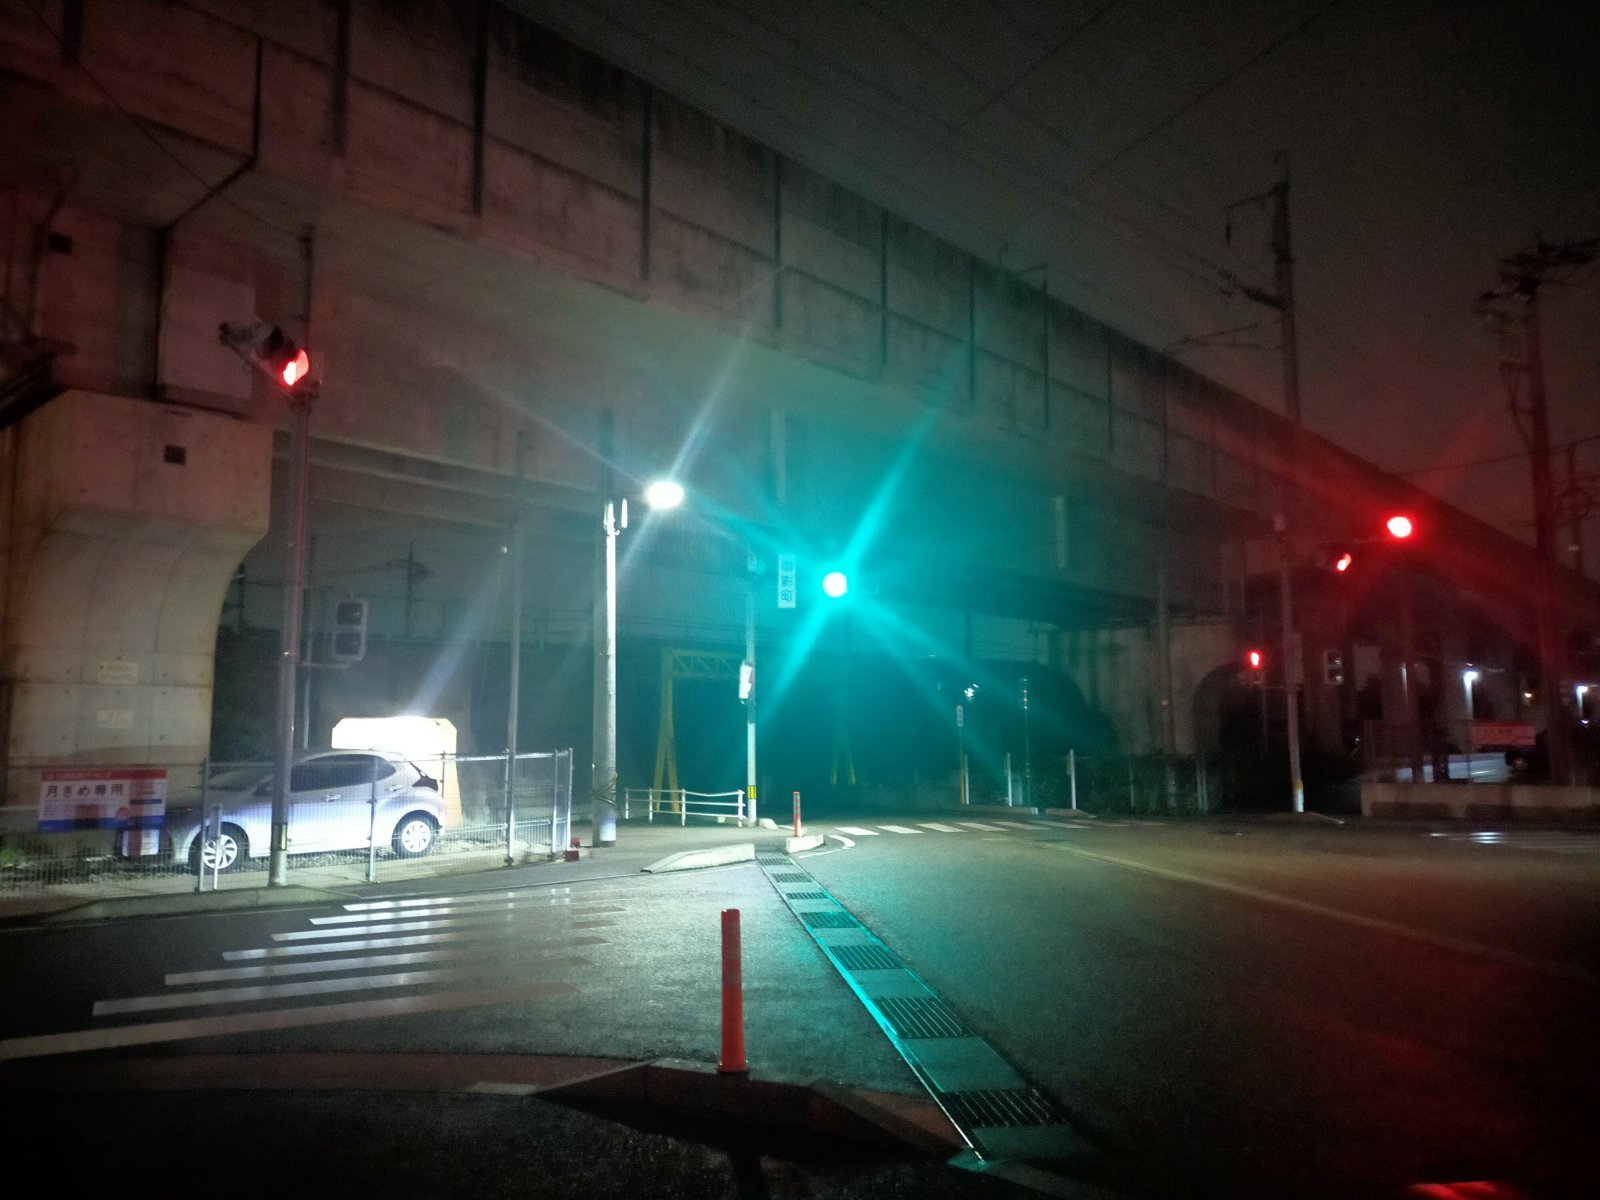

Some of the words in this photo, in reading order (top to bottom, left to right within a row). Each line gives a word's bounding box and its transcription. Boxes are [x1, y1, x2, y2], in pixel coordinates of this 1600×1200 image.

[46, 784, 123, 798] 月ぎめ専用
